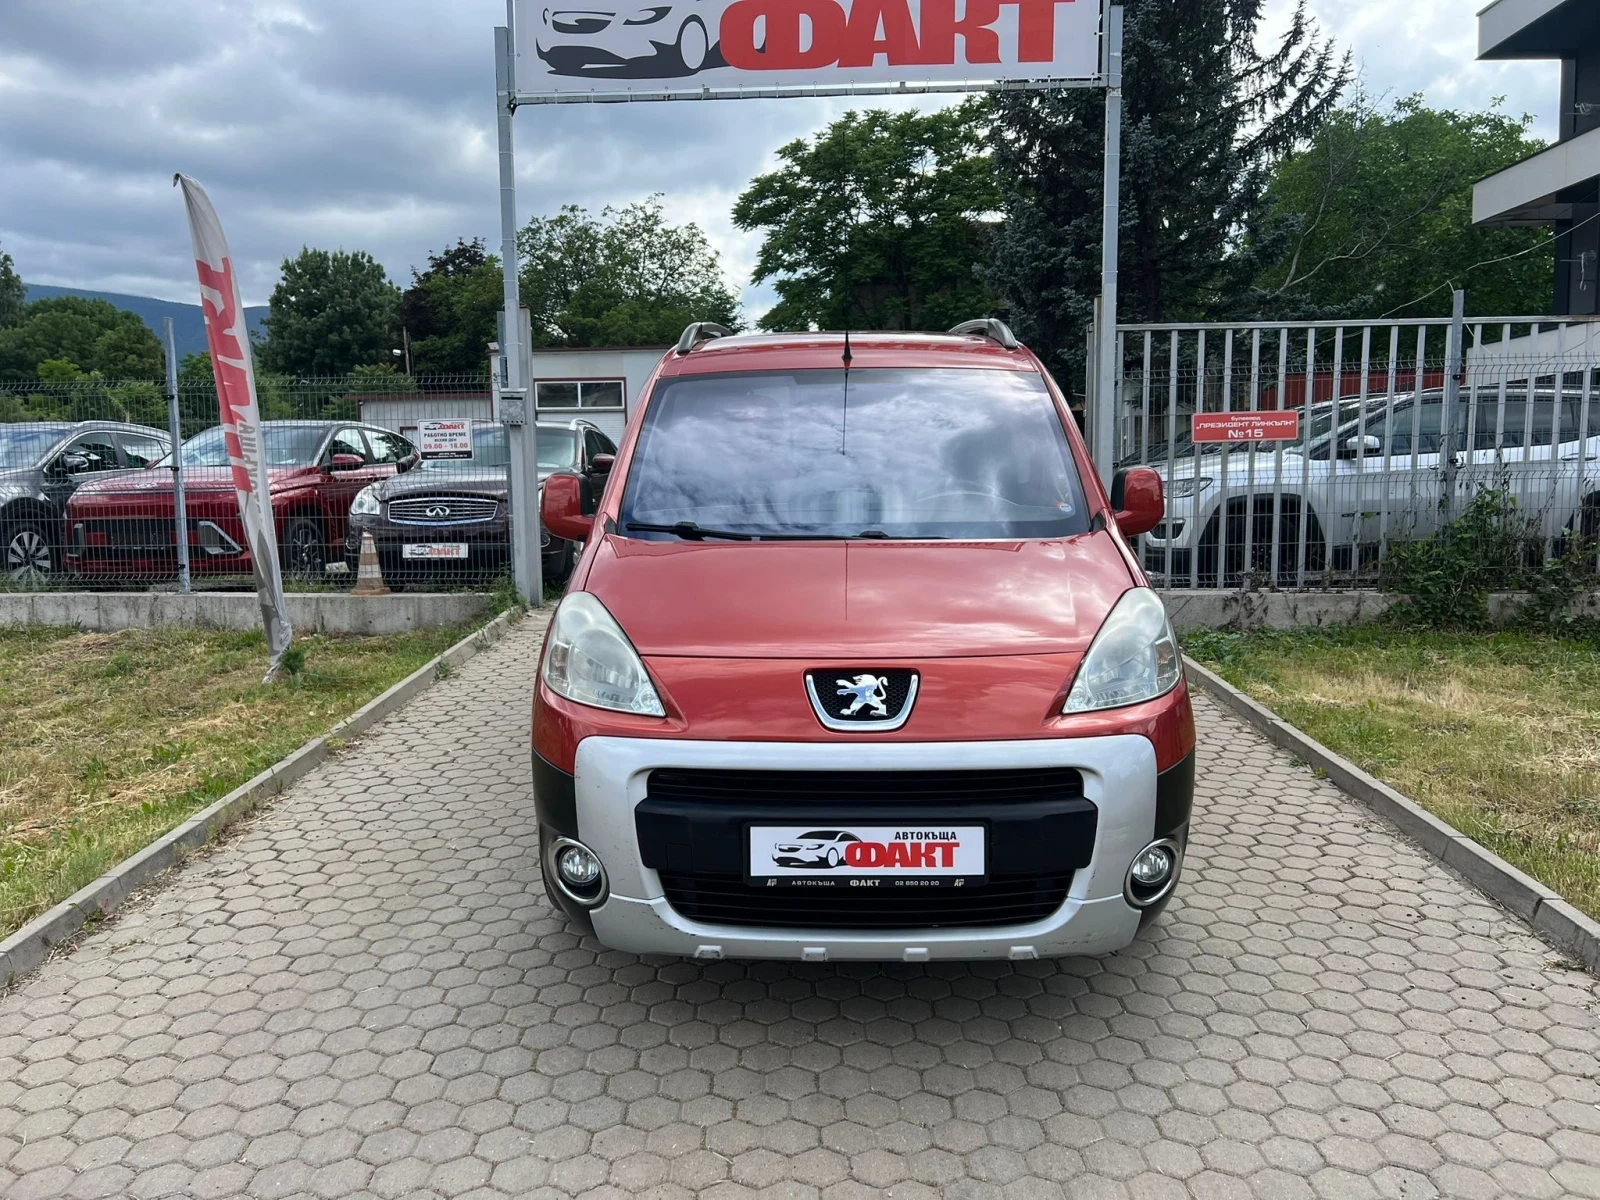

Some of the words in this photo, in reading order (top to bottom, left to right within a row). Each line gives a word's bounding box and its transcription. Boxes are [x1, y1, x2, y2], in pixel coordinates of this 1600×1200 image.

[719, 0, 1075, 70] ФАКТ
[894, 831, 957, 840] АВТОКЪЩА
[845, 842, 960, 868] ФАКТ
[849, 879, 881, 887] ФАКТ
